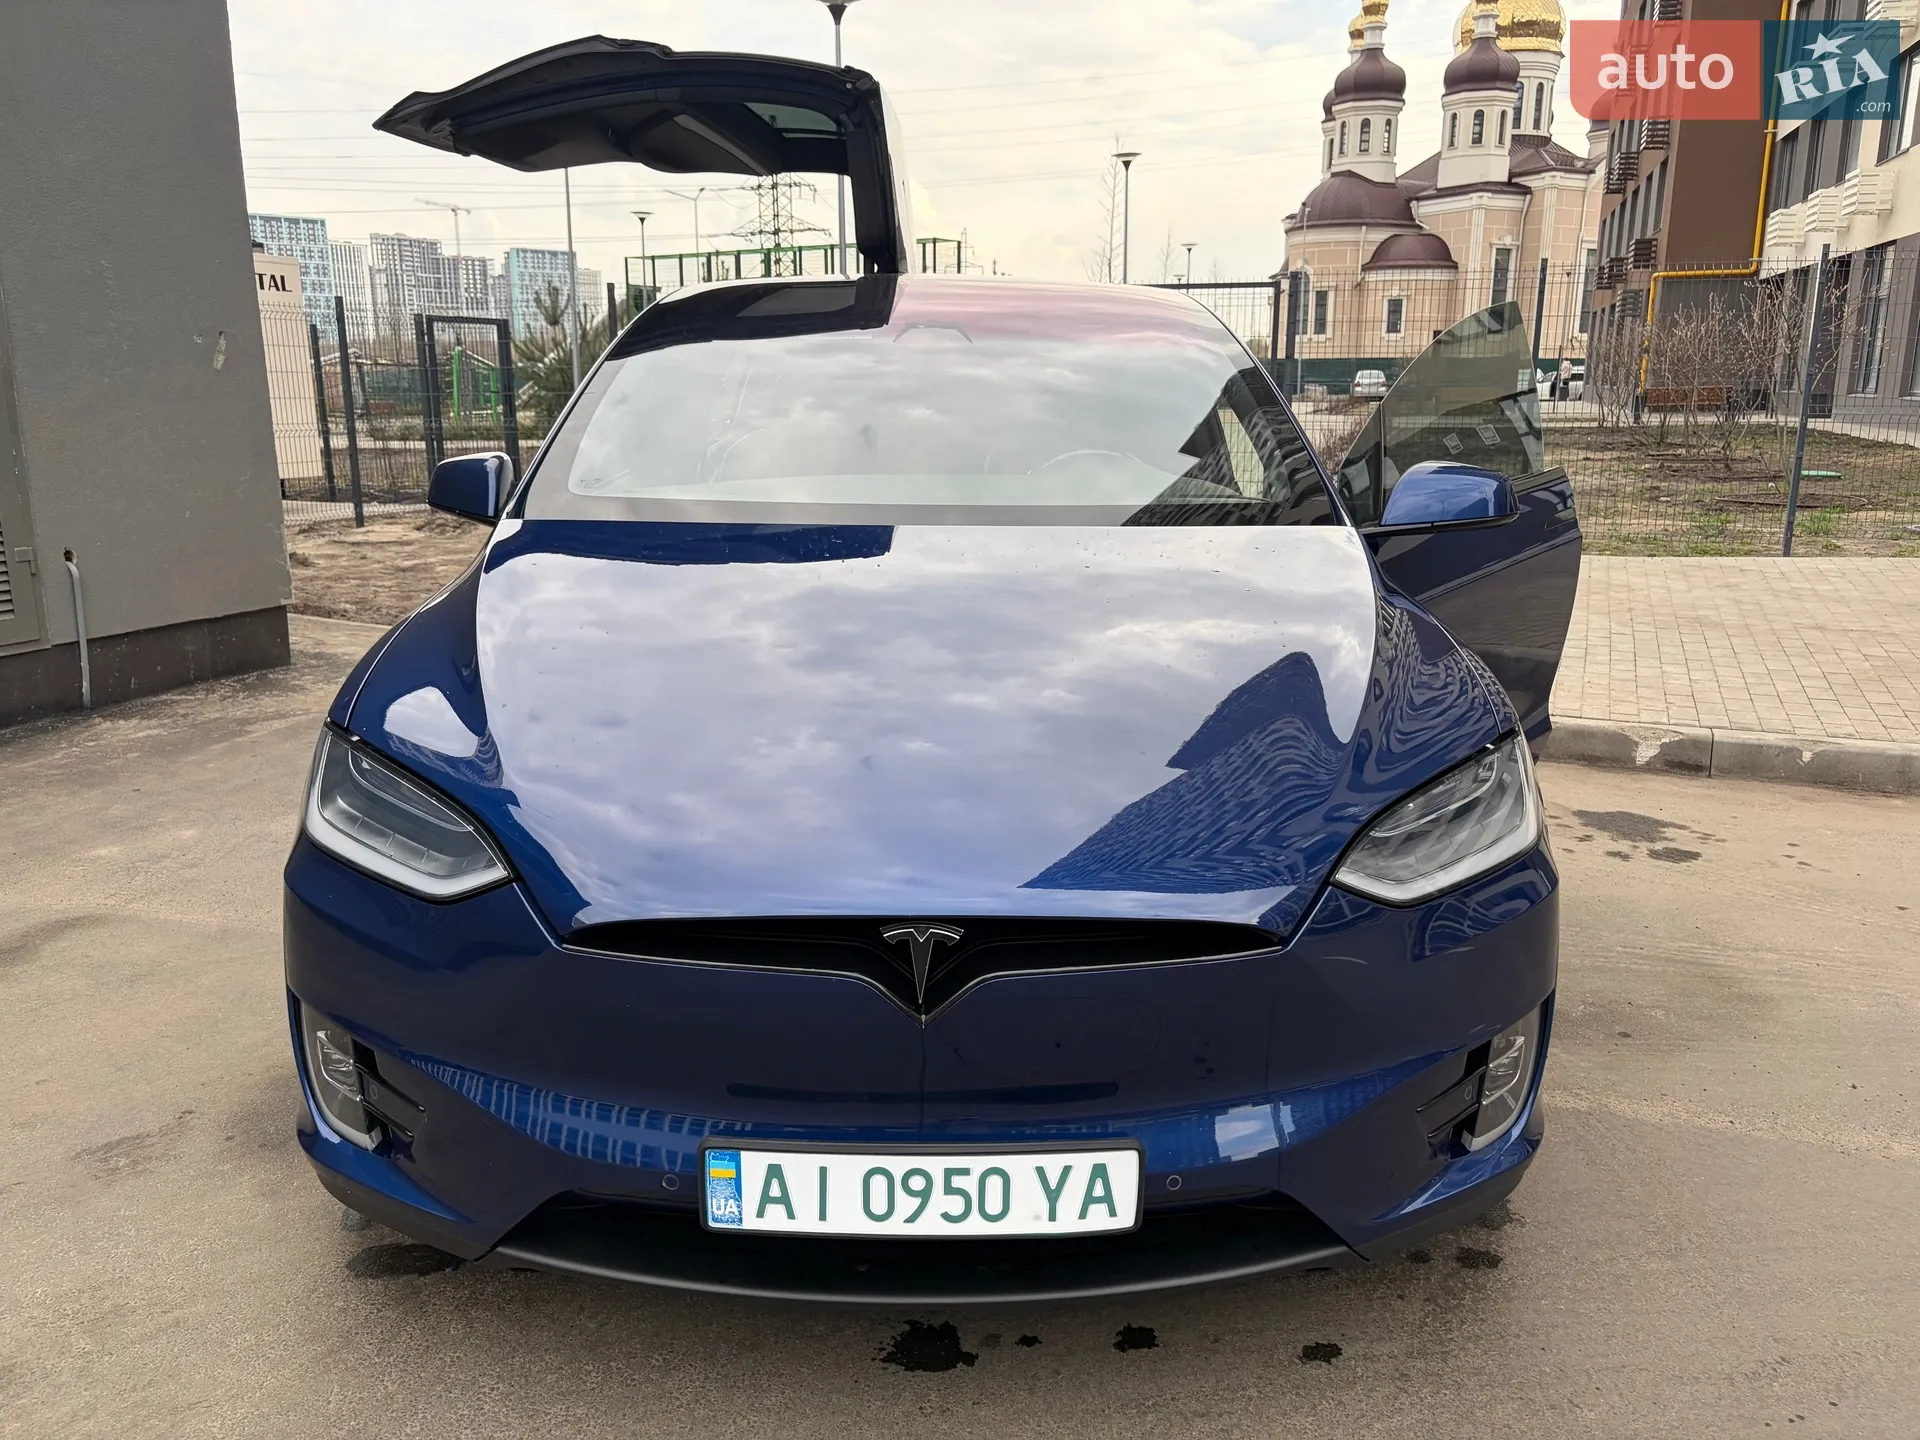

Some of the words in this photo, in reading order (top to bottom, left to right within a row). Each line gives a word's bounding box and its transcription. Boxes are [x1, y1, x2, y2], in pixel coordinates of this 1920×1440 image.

[255, 272, 293, 293] TAL
[755, 1163, 829, 1222] AI
[862, 1166, 1012, 1225] 0950
[1035, 1162, 1118, 1222] YA
[712, 1198, 739, 1215] UA
